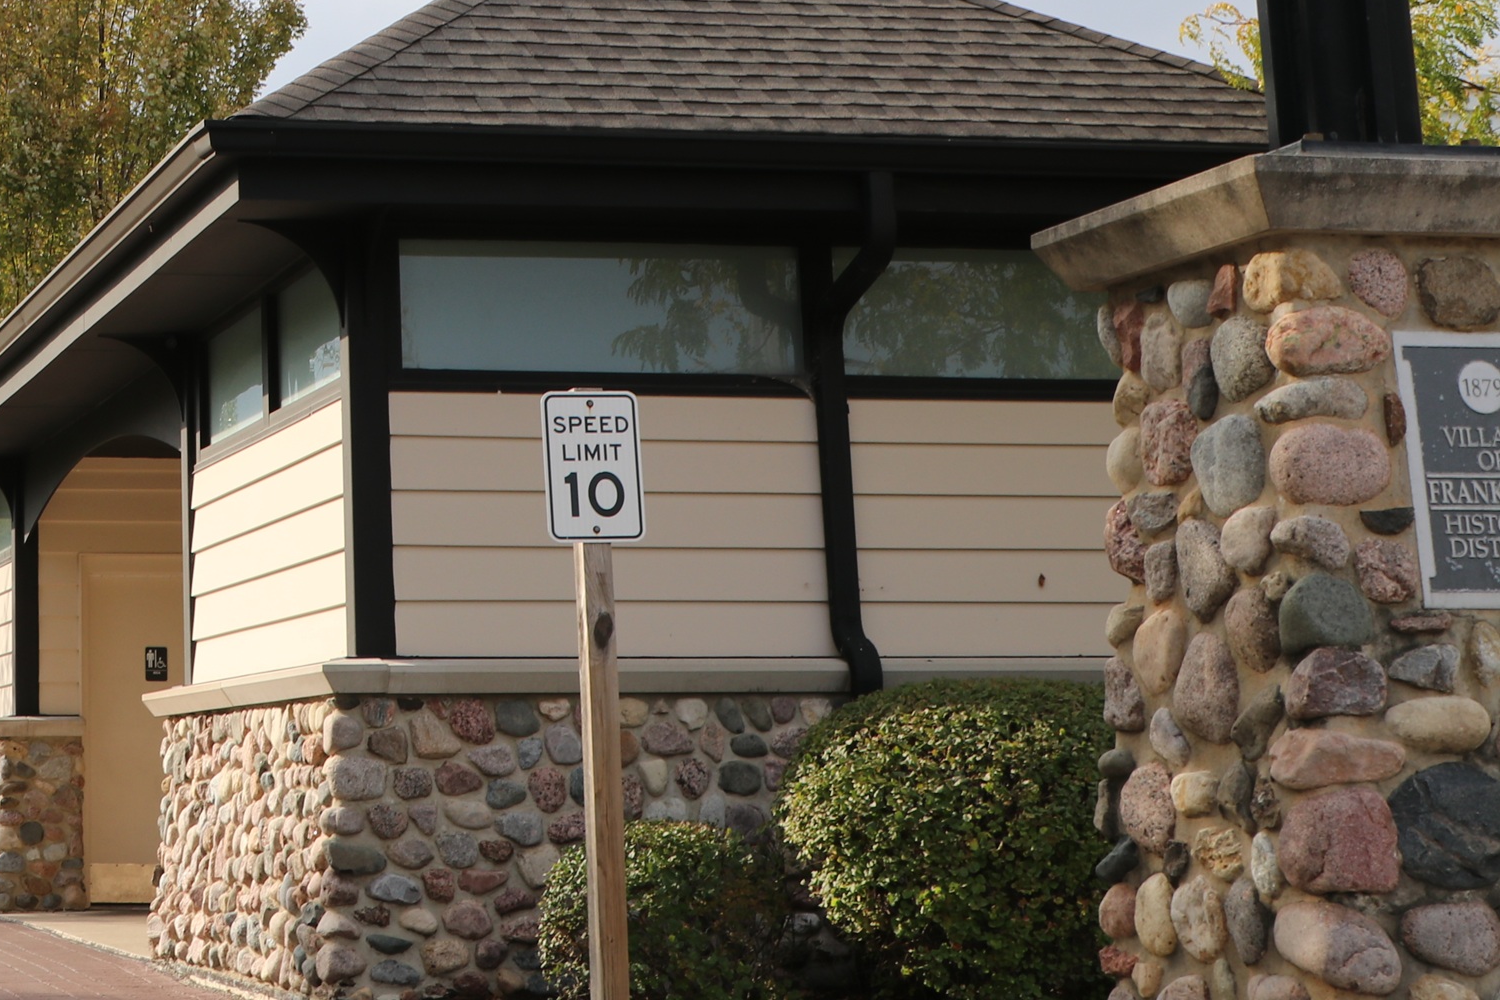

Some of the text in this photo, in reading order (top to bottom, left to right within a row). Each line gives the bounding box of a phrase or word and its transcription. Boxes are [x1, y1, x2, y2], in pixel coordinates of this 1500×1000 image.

[1462, 378, 1500, 397] 1879
[553, 416, 629, 433] SPEED
[562, 444, 622, 461] LIMIT
[564, 471, 625, 518] 10
[1444, 514, 1500, 535] HIST
